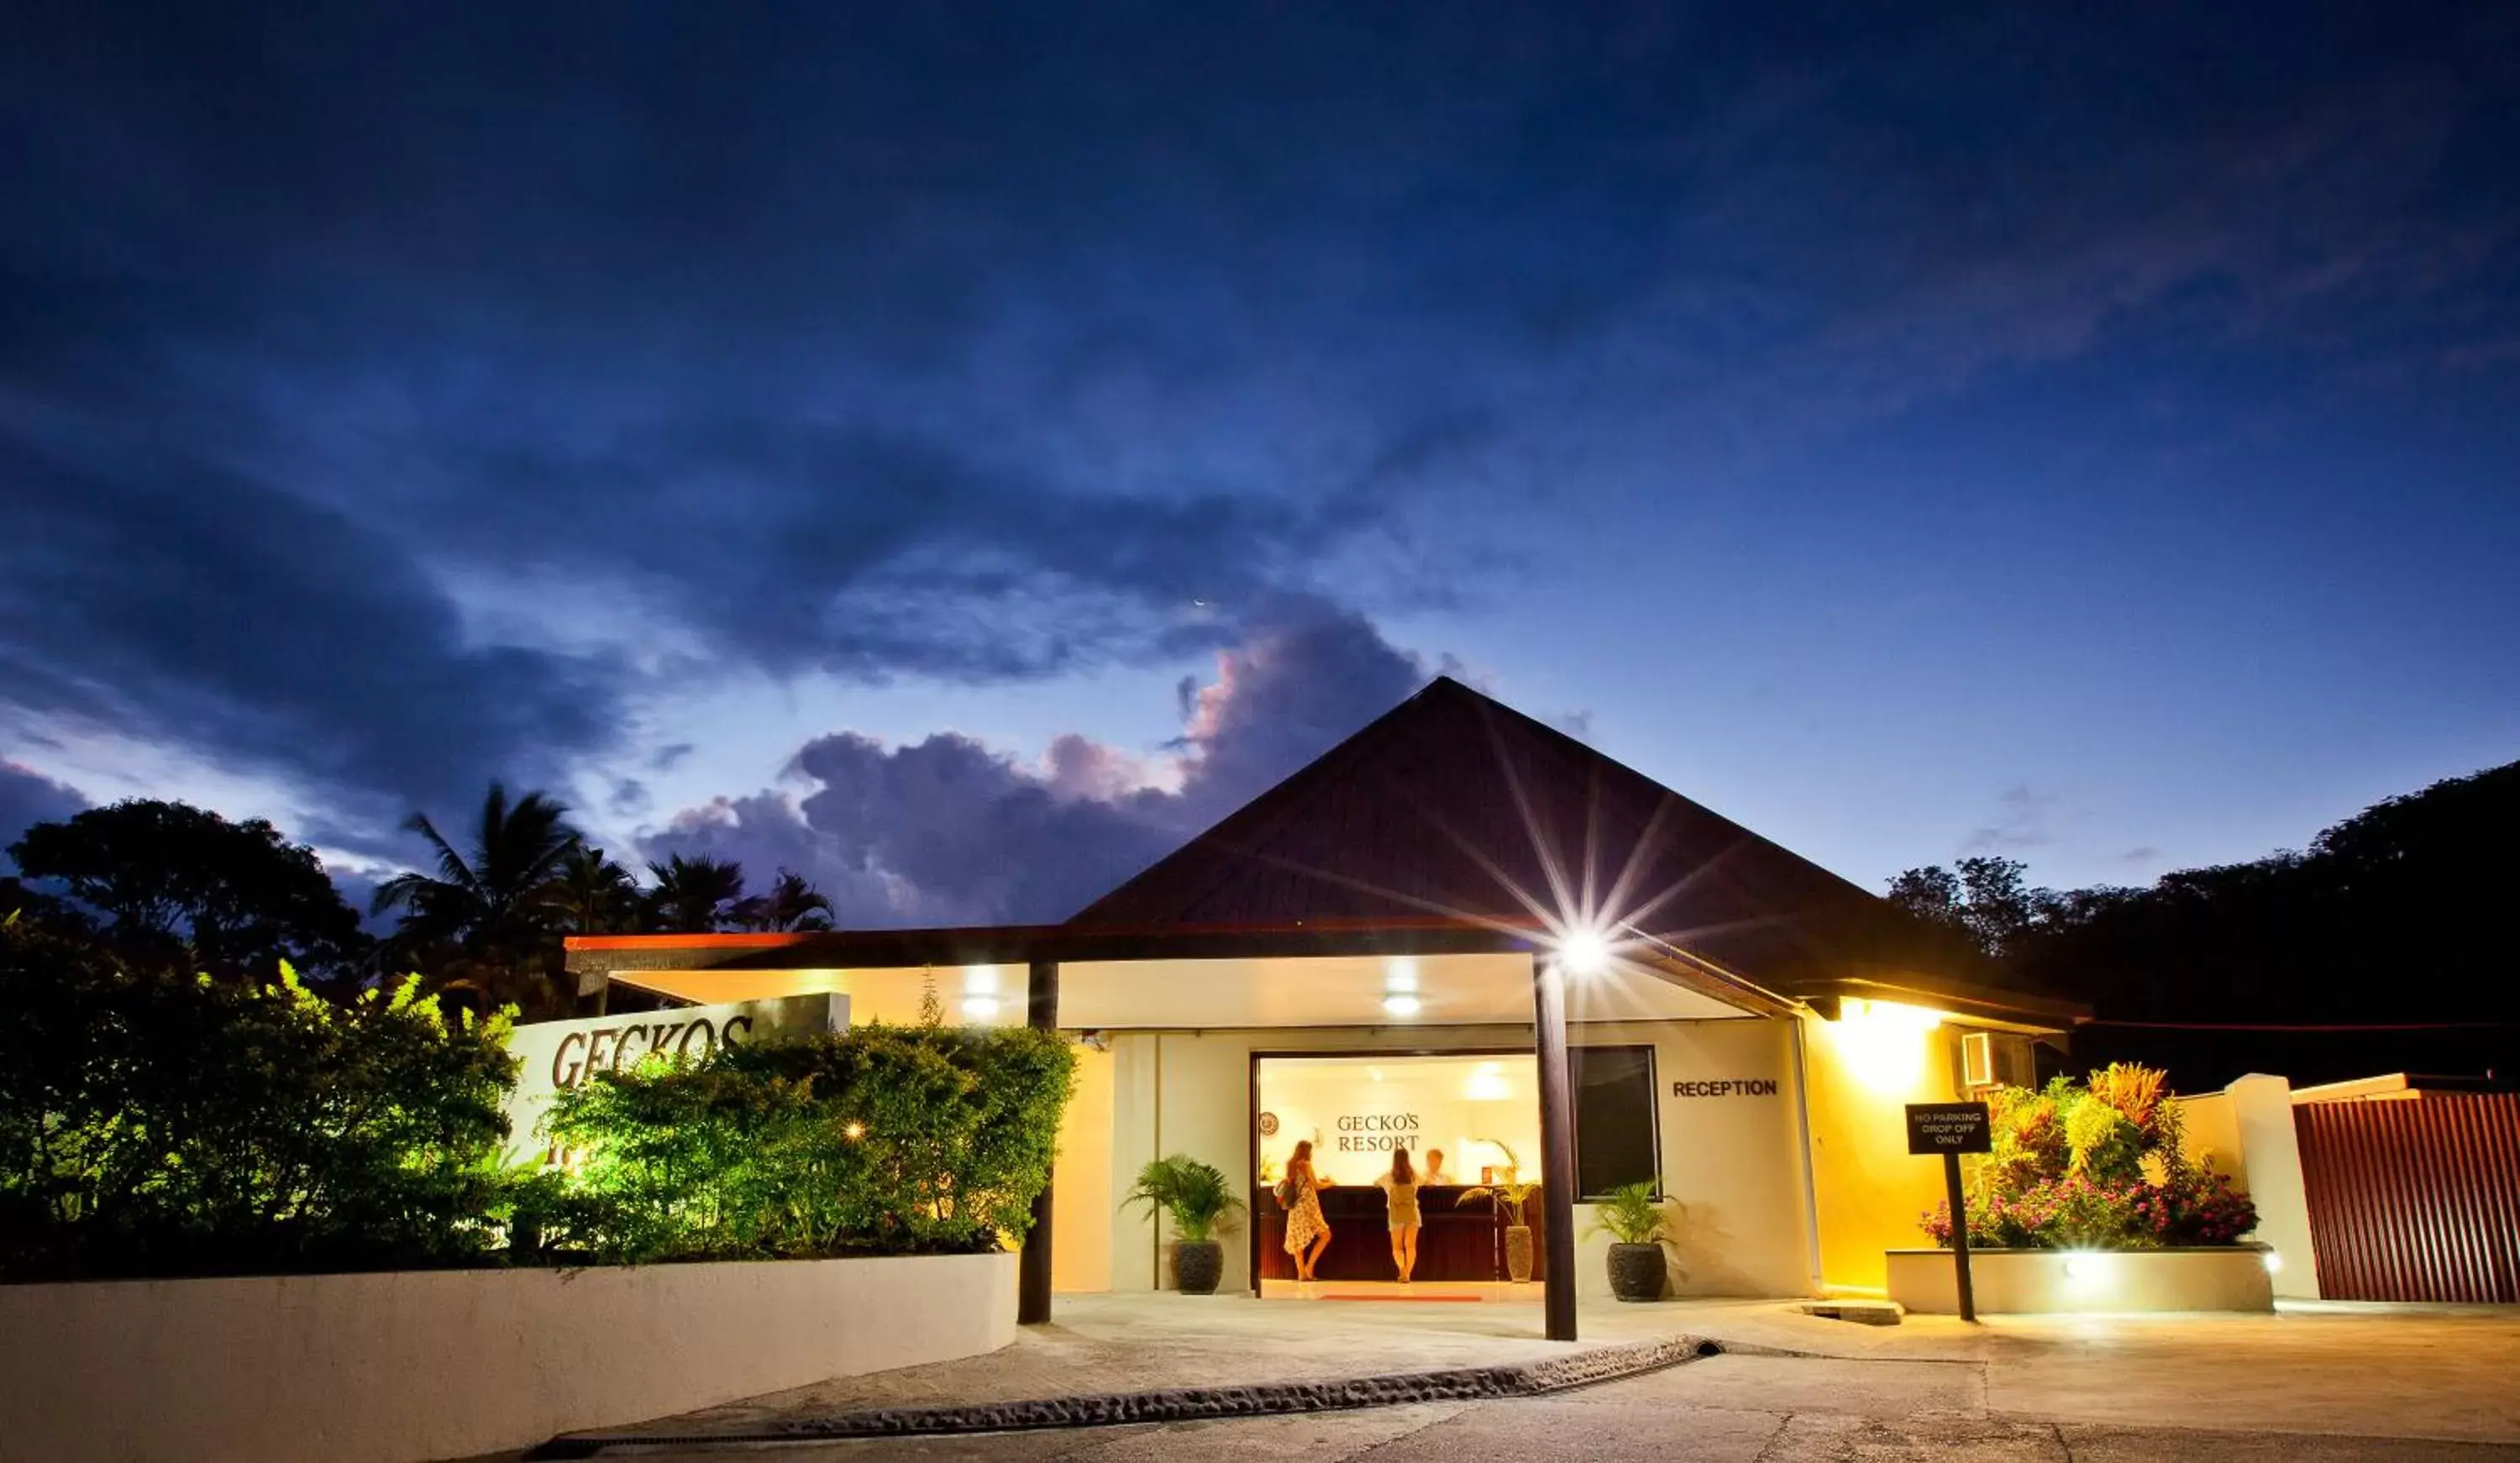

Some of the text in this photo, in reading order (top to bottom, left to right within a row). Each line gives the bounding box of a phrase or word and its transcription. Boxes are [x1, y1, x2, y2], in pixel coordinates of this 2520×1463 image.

[1672, 1079, 1777, 1097] RECEPTION
[1337, 1113, 1420, 1131] GECKO'S
[1915, 1112, 1982, 1123] NO PARKING
[1921, 1124, 1976, 1134] DROP OFF
[1338, 1135, 1420, 1151] RESORT
[1935, 1135, 1964, 1145] ONLY
